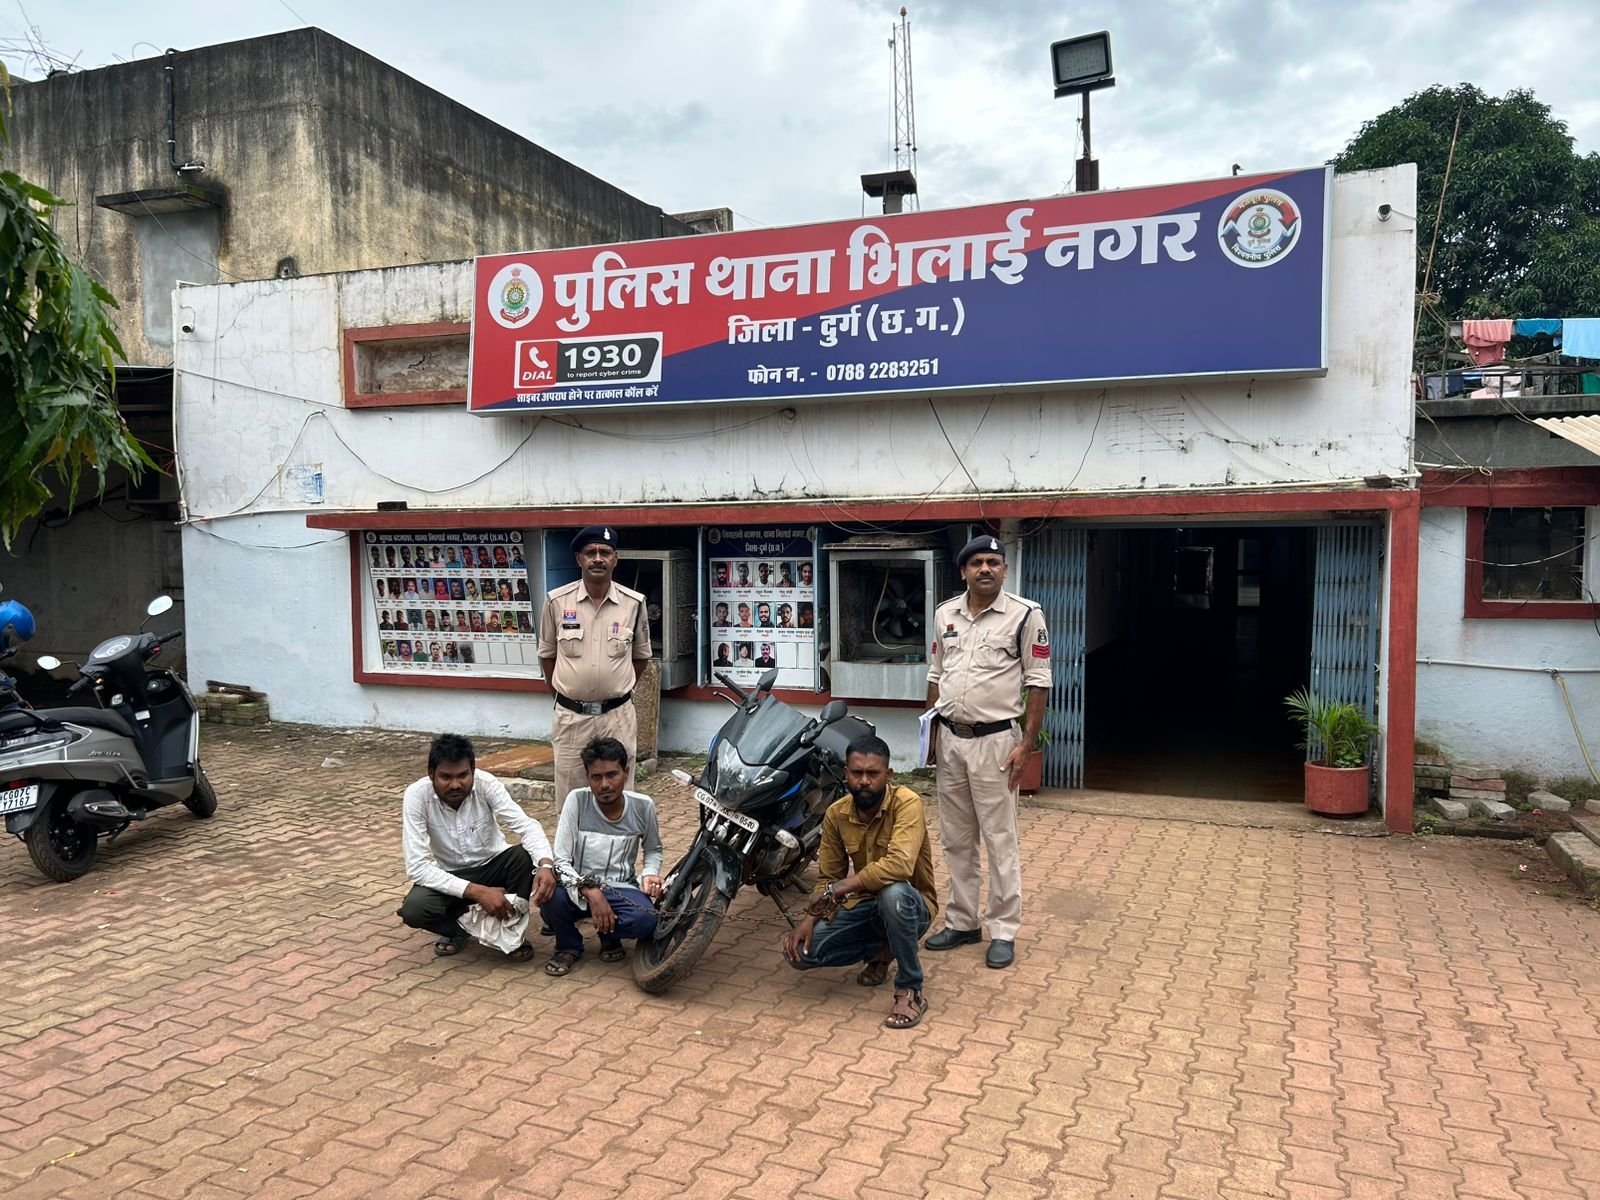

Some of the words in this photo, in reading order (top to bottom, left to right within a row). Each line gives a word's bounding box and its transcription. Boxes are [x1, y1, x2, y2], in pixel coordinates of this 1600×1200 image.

[553, 251, 695, 333] पुलिस
[706, 248, 836, 302] थाना
[846, 208, 1035, 292] भिलाई
[1044, 211, 1201, 271] नगर
[727, 314, 797, 345] जिला
[819, 304, 862, 348] दुर्ग
[866, 297, 965, 342] (छ.ग.)
[564, 343, 642, 369] 1930
[522, 371, 554, 381] DIAL
[576, 371, 598, 380] report
[599, 370, 620, 379] cyber
[748, 365, 782, 384] फोन
[785, 366, 805, 382] न.
[826, 364, 865, 381] 0788
[869, 358, 939, 380] 2283251
[517, 391, 540, 404] साइबर
[541, 391, 567, 403] अपराध
[569, 388, 582, 401] होने
[584, 390, 594, 401] पर
[596, 388, 623, 400] तत्काल
[625, 386, 643, 399] कॉल
[645, 384, 660, 398] करें
[3, 787, 30, 801] CG07C
[3, 796, 30, 809] Y7167
